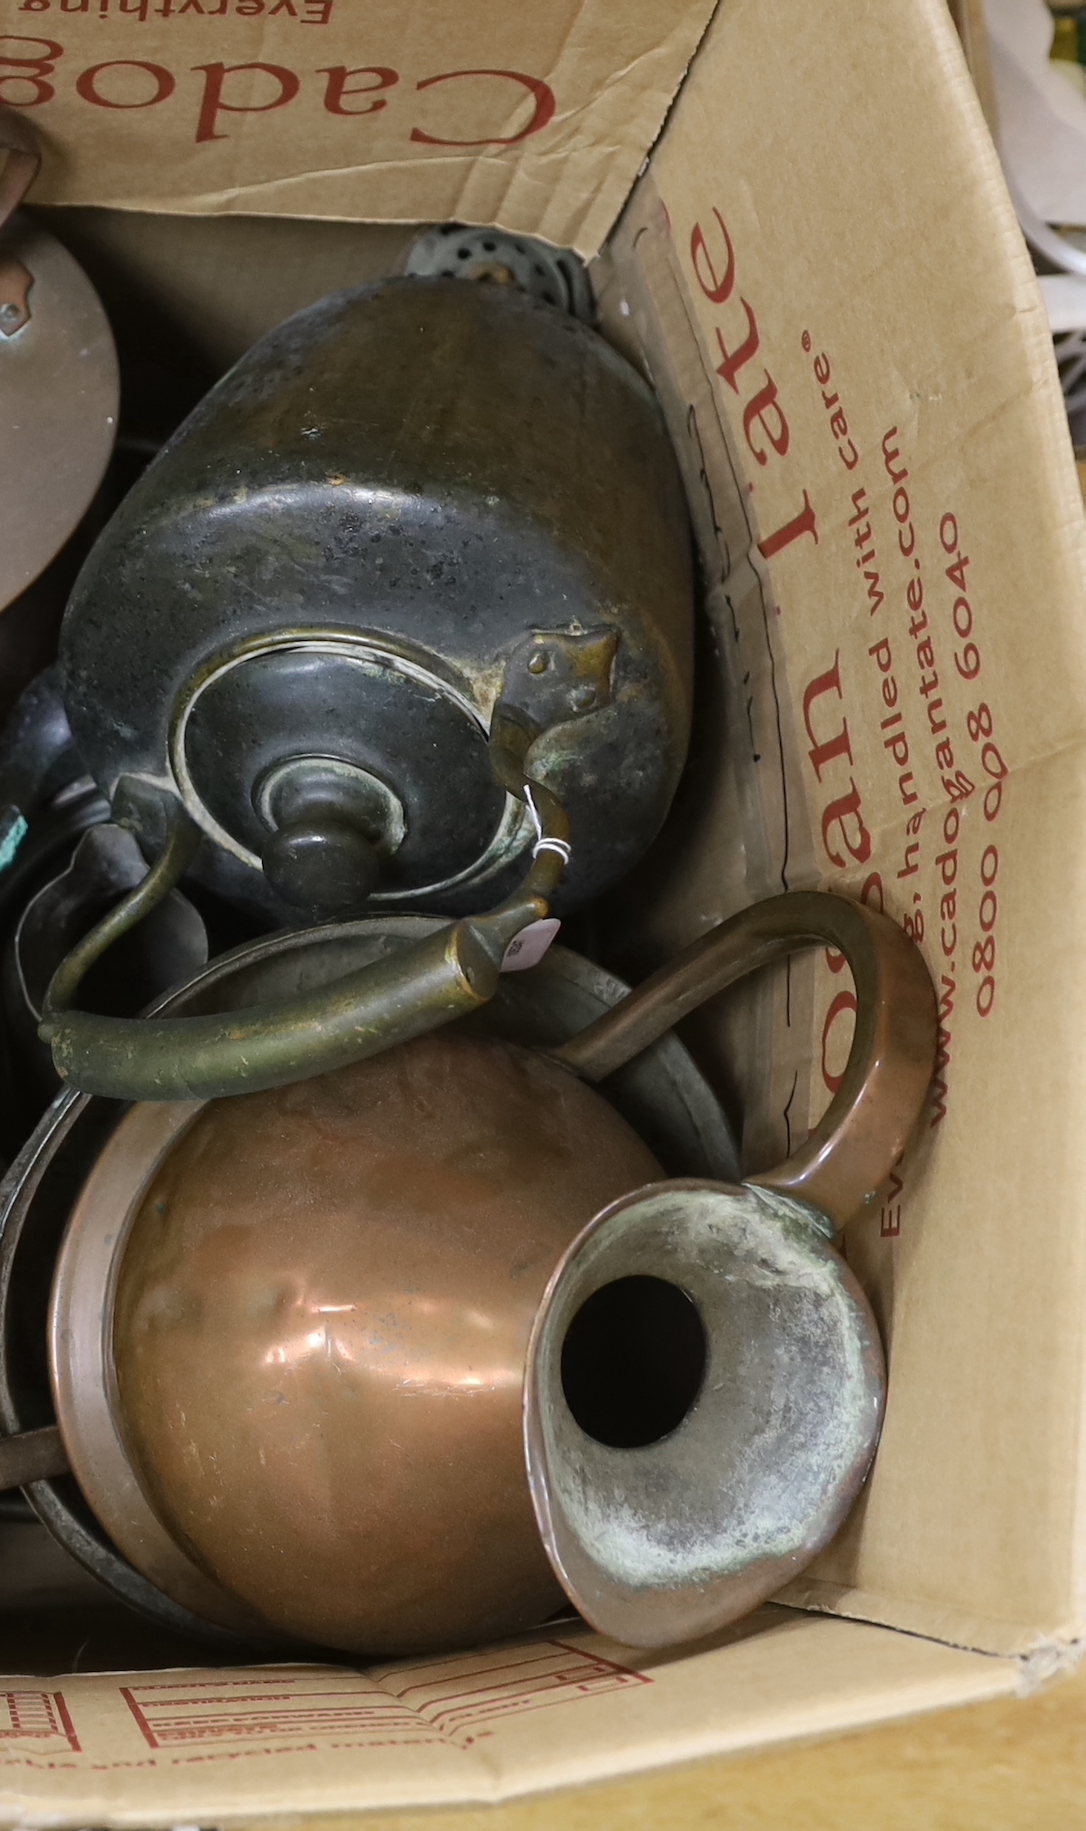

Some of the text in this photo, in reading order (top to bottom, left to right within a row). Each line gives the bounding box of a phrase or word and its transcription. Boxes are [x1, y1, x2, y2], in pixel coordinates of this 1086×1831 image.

[847, 487, 887, 616] with
[868, 637, 928, 879] handled
[938, 511, 1010, 1019] 0800 008 6040
